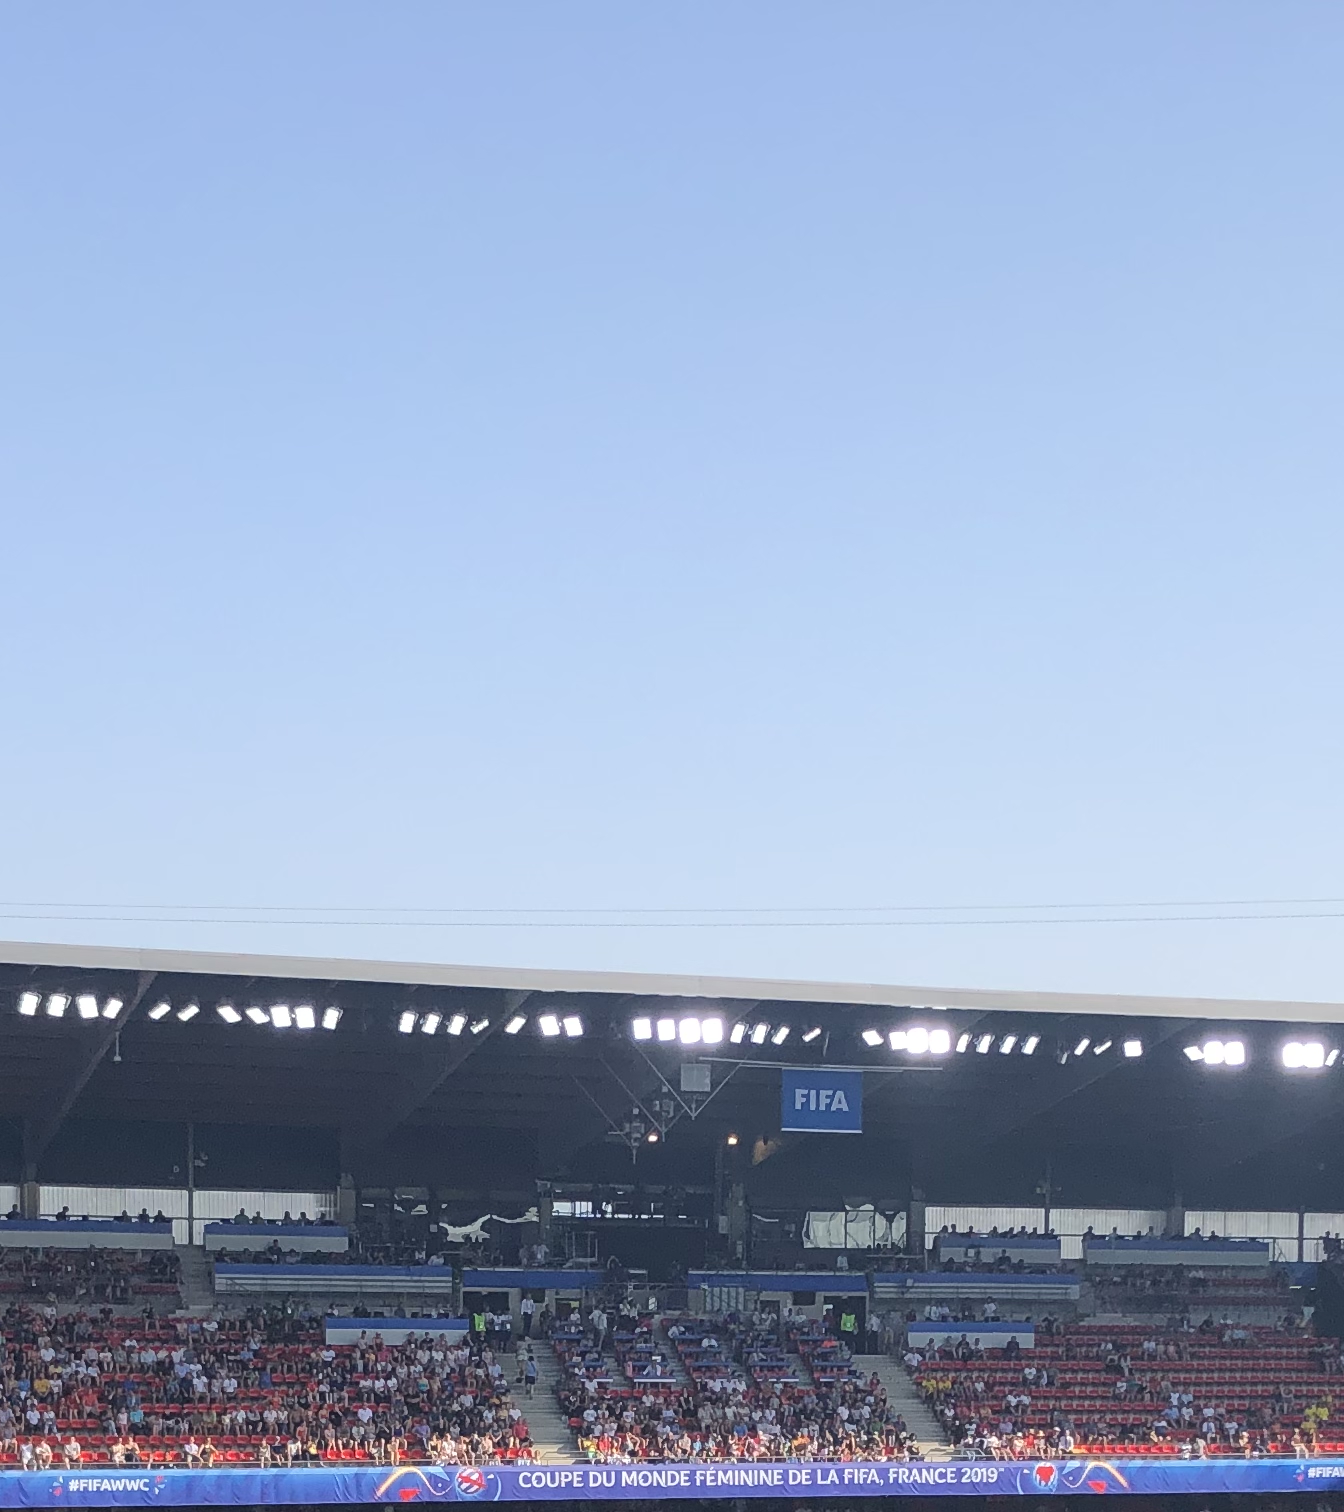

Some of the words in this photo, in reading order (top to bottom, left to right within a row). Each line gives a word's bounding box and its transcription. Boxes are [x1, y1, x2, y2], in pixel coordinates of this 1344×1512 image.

[795, 1089, 849, 1111] FIFA
[68, 1478, 150, 1492] #FIFAWWC
[518, 1471, 584, 1488] COUPE
[589, 1471, 615, 1487] DU
[621, 1470, 690, 1488] MONDE
[694, 1467, 784, 1487] FÉMININE
[788, 1469, 812, 1485] DE
[816, 1469, 839, 1485] LA
[843, 1468, 884, 1487] FIFA,
[888, 1467, 957, 1485] FRANCE
